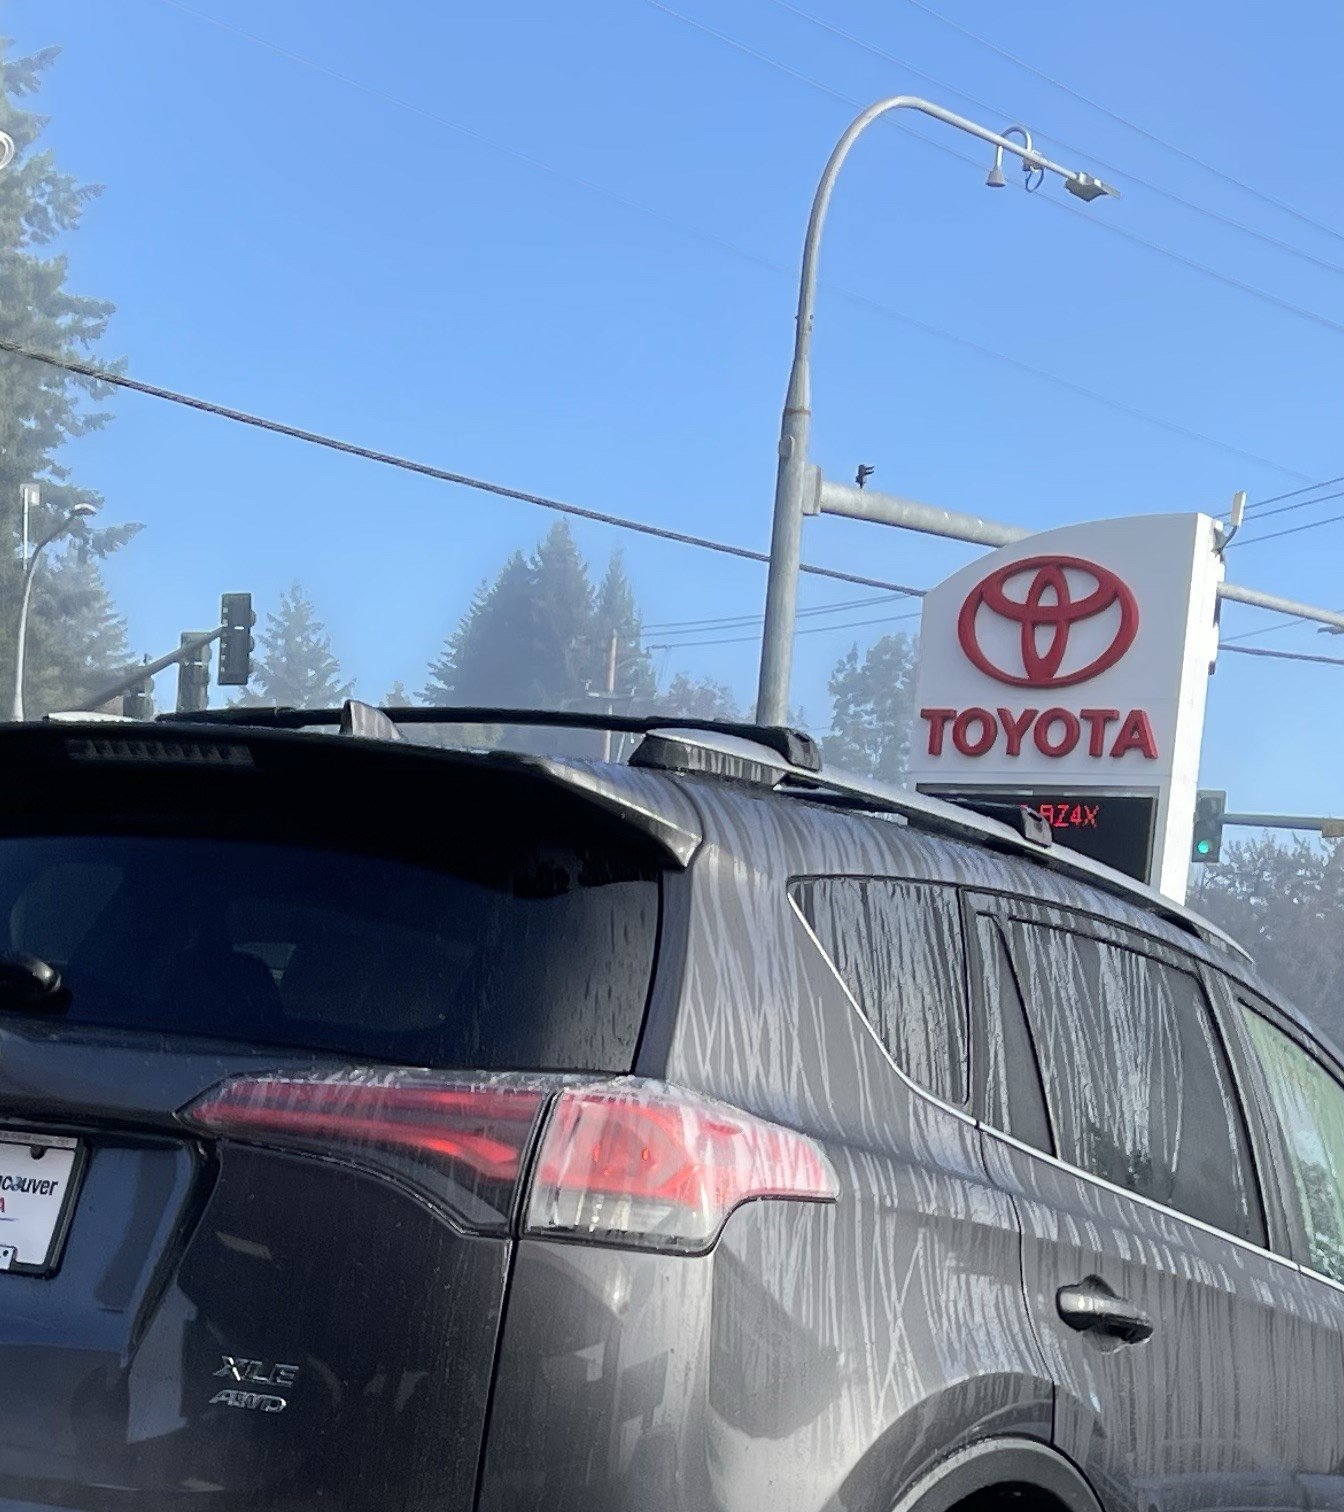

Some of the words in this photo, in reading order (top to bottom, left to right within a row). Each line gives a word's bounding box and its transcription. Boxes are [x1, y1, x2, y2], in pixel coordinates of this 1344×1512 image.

[920, 707, 1159, 760] TOYOTA
[212, 1355, 300, 1388] XLE
[209, 1389, 287, 1413] AWD
